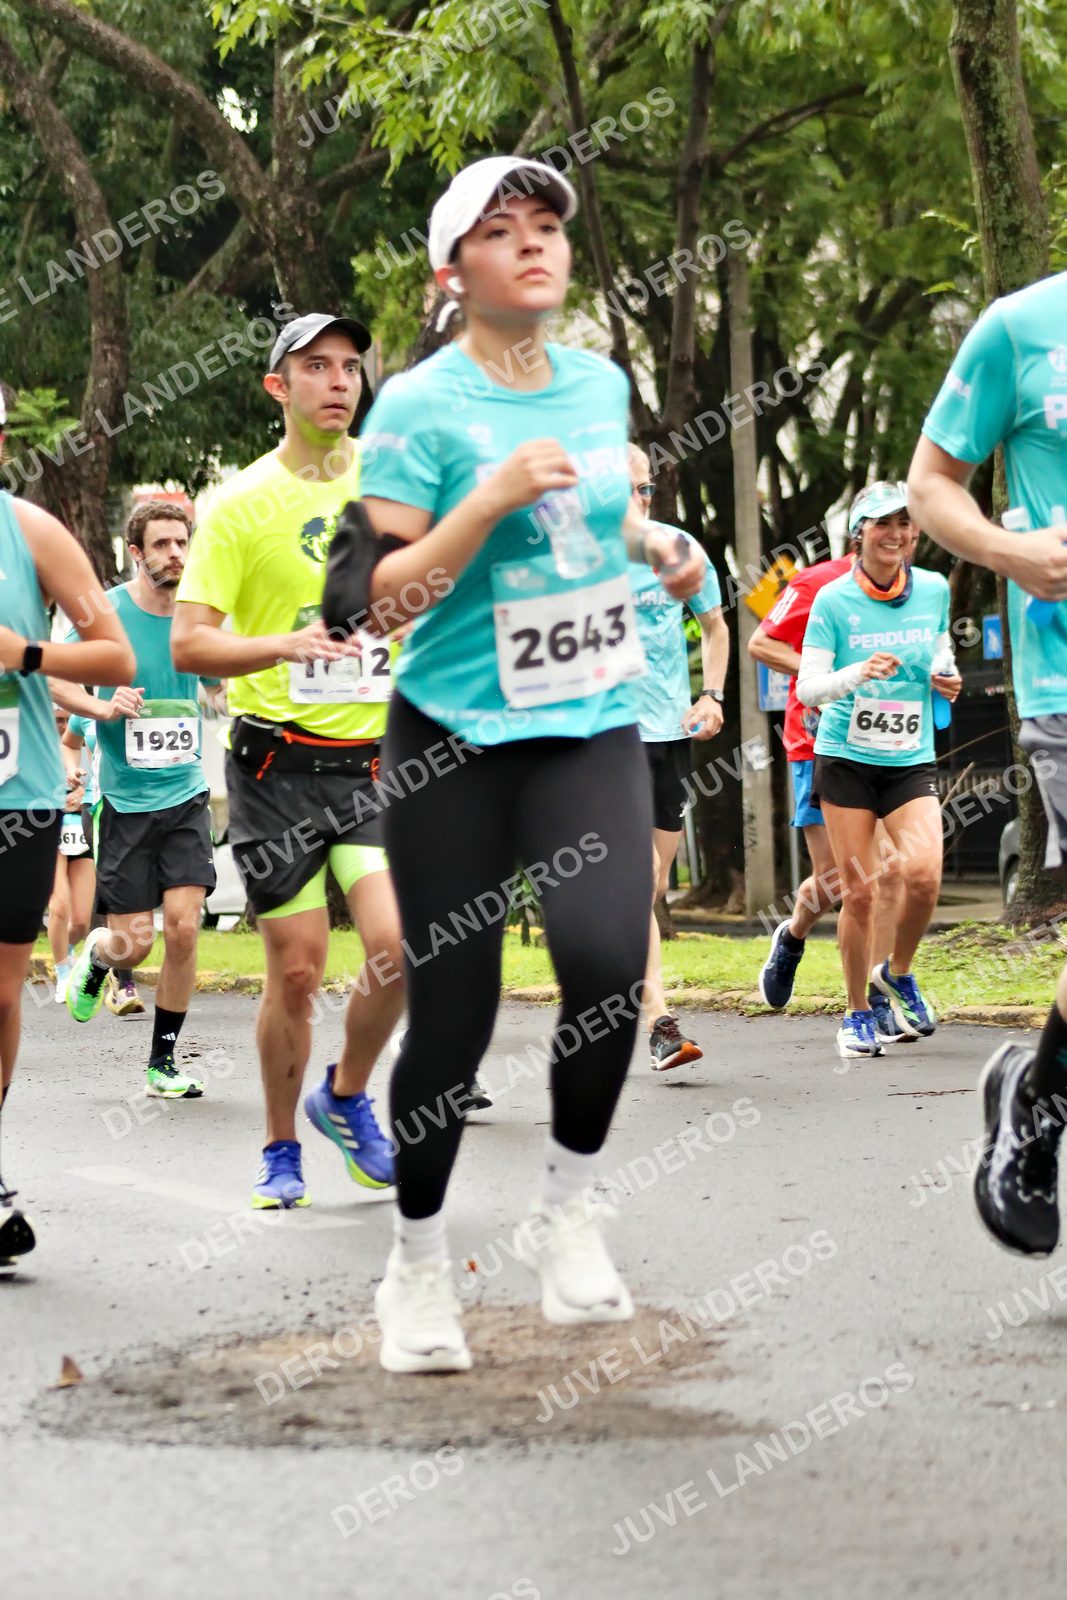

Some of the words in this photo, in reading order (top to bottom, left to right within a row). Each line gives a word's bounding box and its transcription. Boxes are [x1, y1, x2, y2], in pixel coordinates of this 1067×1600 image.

[510, 604, 626, 670] 2643
[848, 628, 933, 650] PERDURA
[856, 711, 920, 734] 6436
[133, 730, 193, 752] 1929
